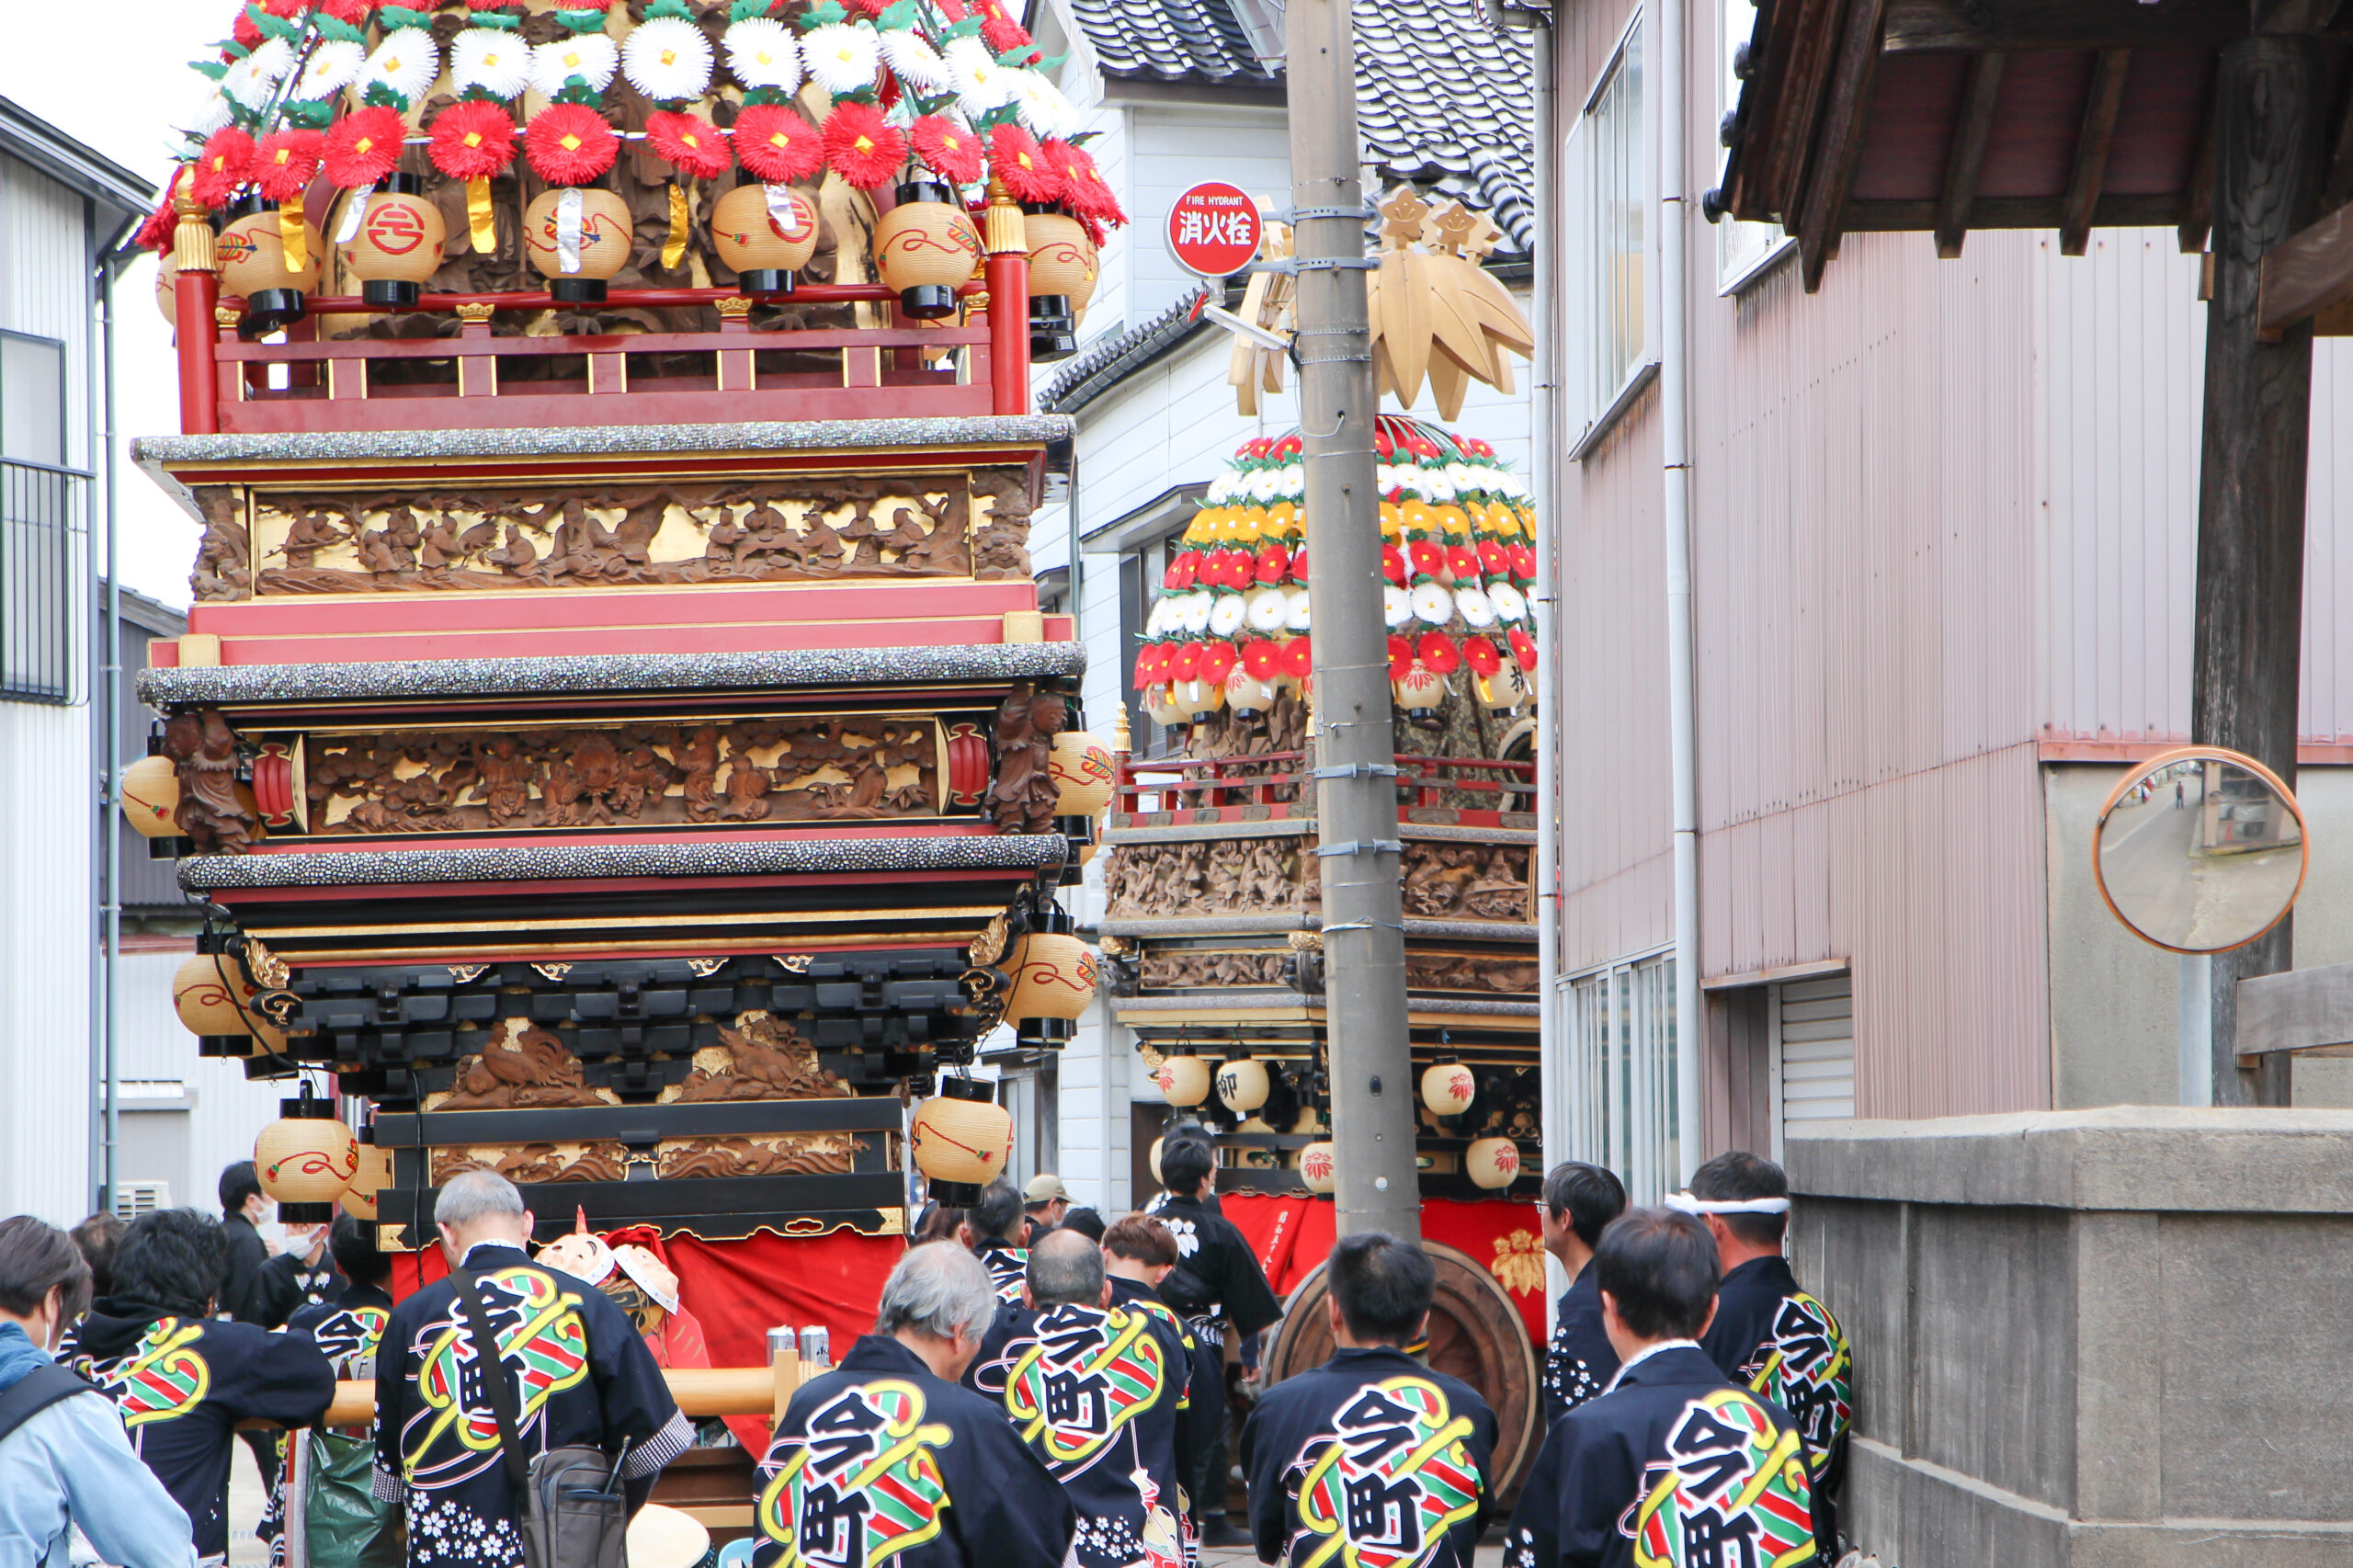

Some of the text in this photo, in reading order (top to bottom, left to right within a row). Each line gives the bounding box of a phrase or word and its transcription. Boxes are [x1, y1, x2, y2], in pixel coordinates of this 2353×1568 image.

[1178, 210, 1252, 245] 消火栓
[1186, 196, 1244, 207] FIRE HYDRANT
[1034, 1304, 1114, 1439] 今町
[1773, 1297, 1837, 1454] 今町
[798, 1387, 892, 1568] 今町
[1333, 1386, 1427, 1557] 今町
[1666, 1401, 1764, 1568] 今町
